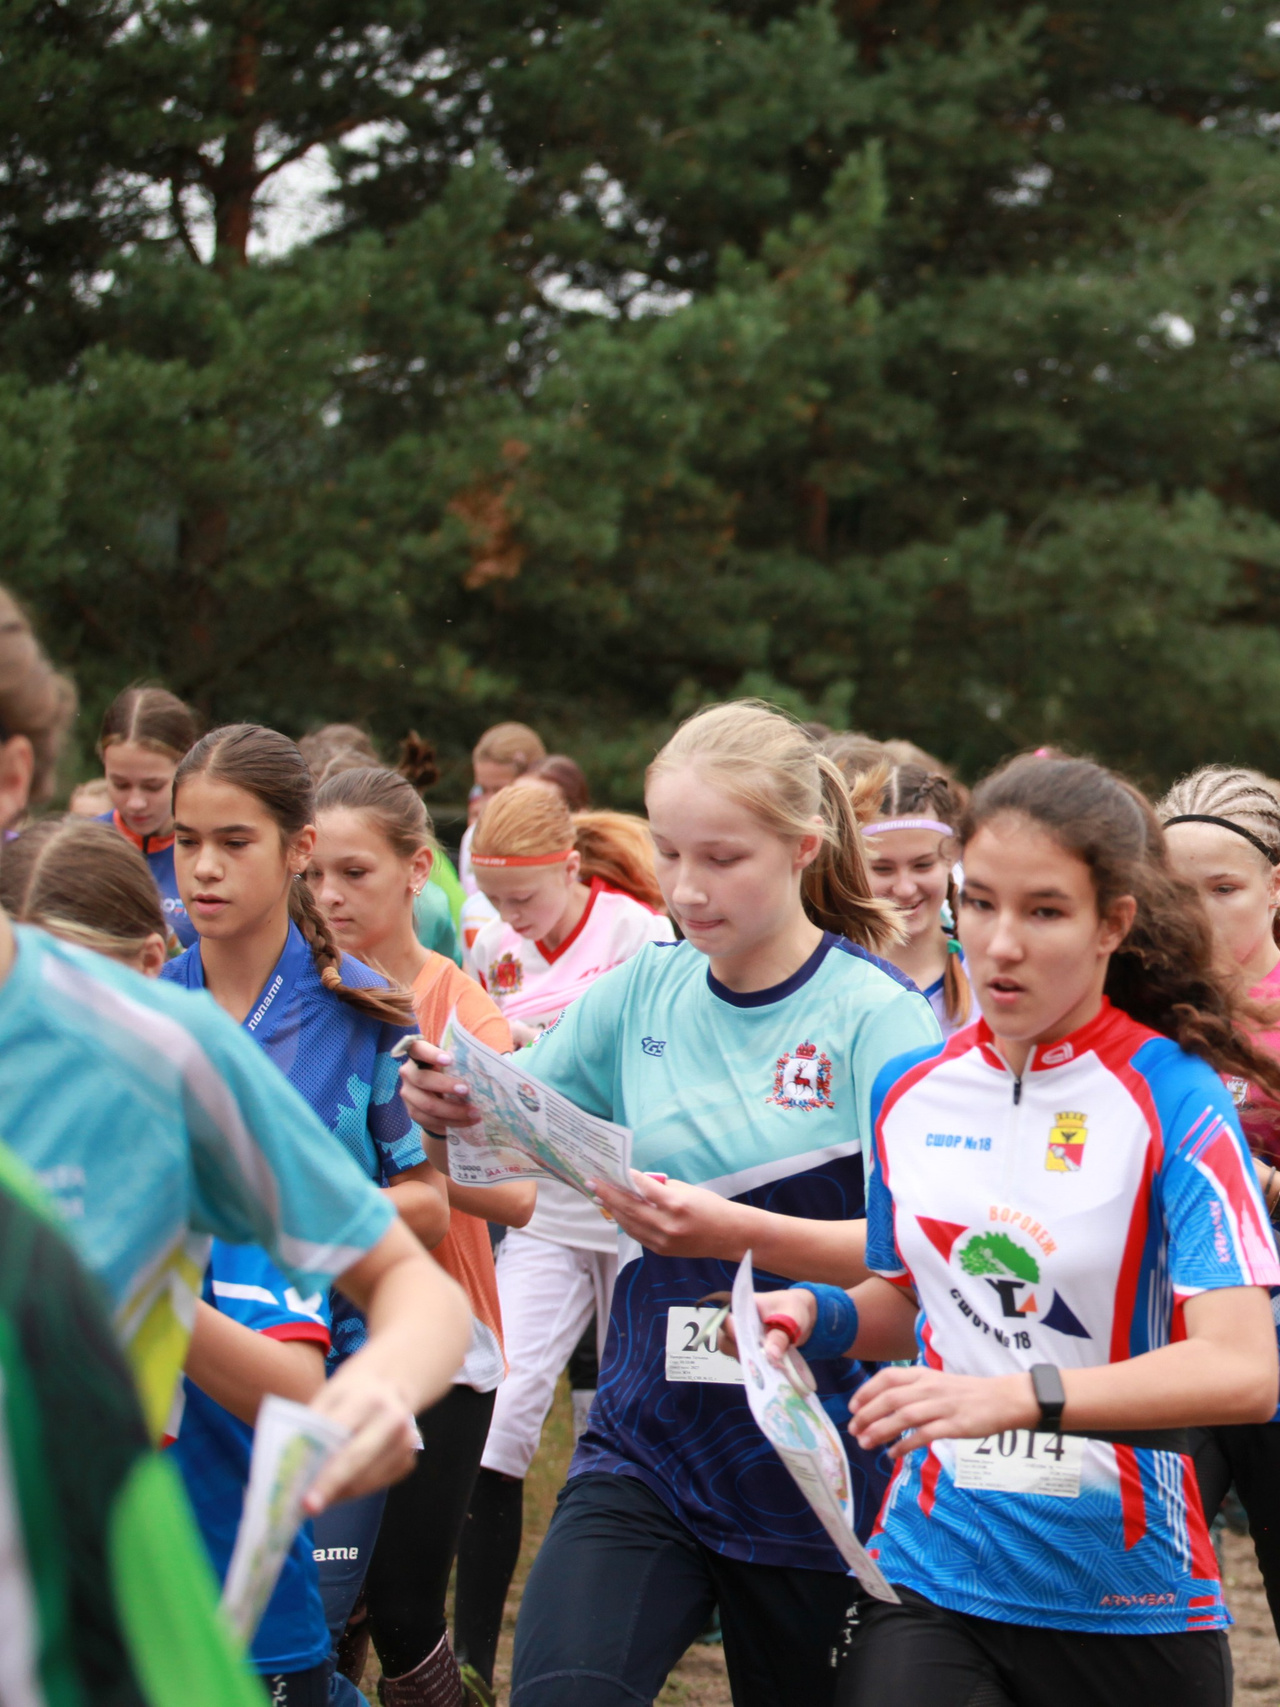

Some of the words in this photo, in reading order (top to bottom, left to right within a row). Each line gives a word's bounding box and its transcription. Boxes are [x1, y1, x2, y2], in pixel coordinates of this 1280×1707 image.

[248, 975, 284, 1031] noname
[926, 1133, 962, 1148] СШОР
[989, 1206, 1057, 1257] ВОРОНЕЖ
[312, 1547, 359, 1562] ame
